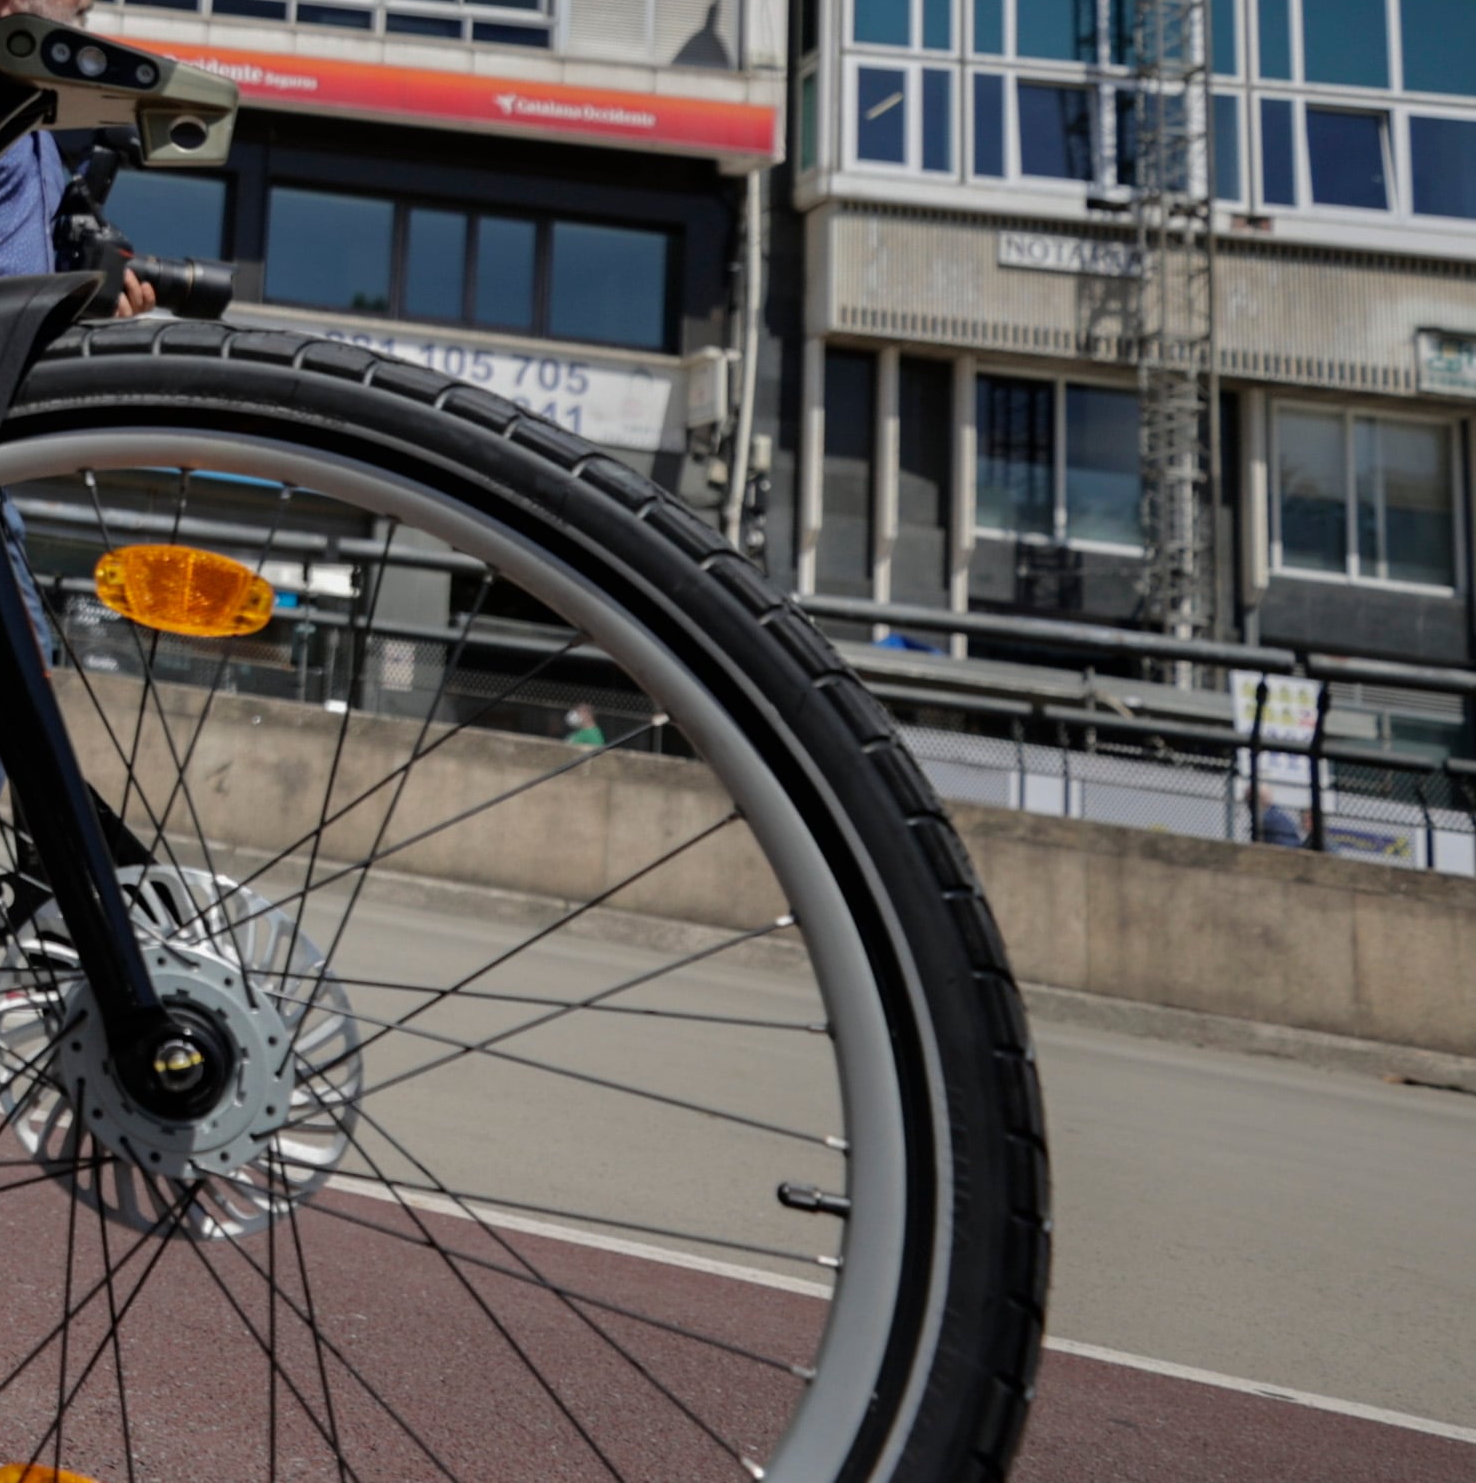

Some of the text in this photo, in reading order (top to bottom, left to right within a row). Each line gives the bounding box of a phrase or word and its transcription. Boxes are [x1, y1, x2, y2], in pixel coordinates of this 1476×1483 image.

[265, 70, 319, 90] Seguros
[517, 97, 657, 128] Catalana Occidente
[512, 354, 590, 396] 705
